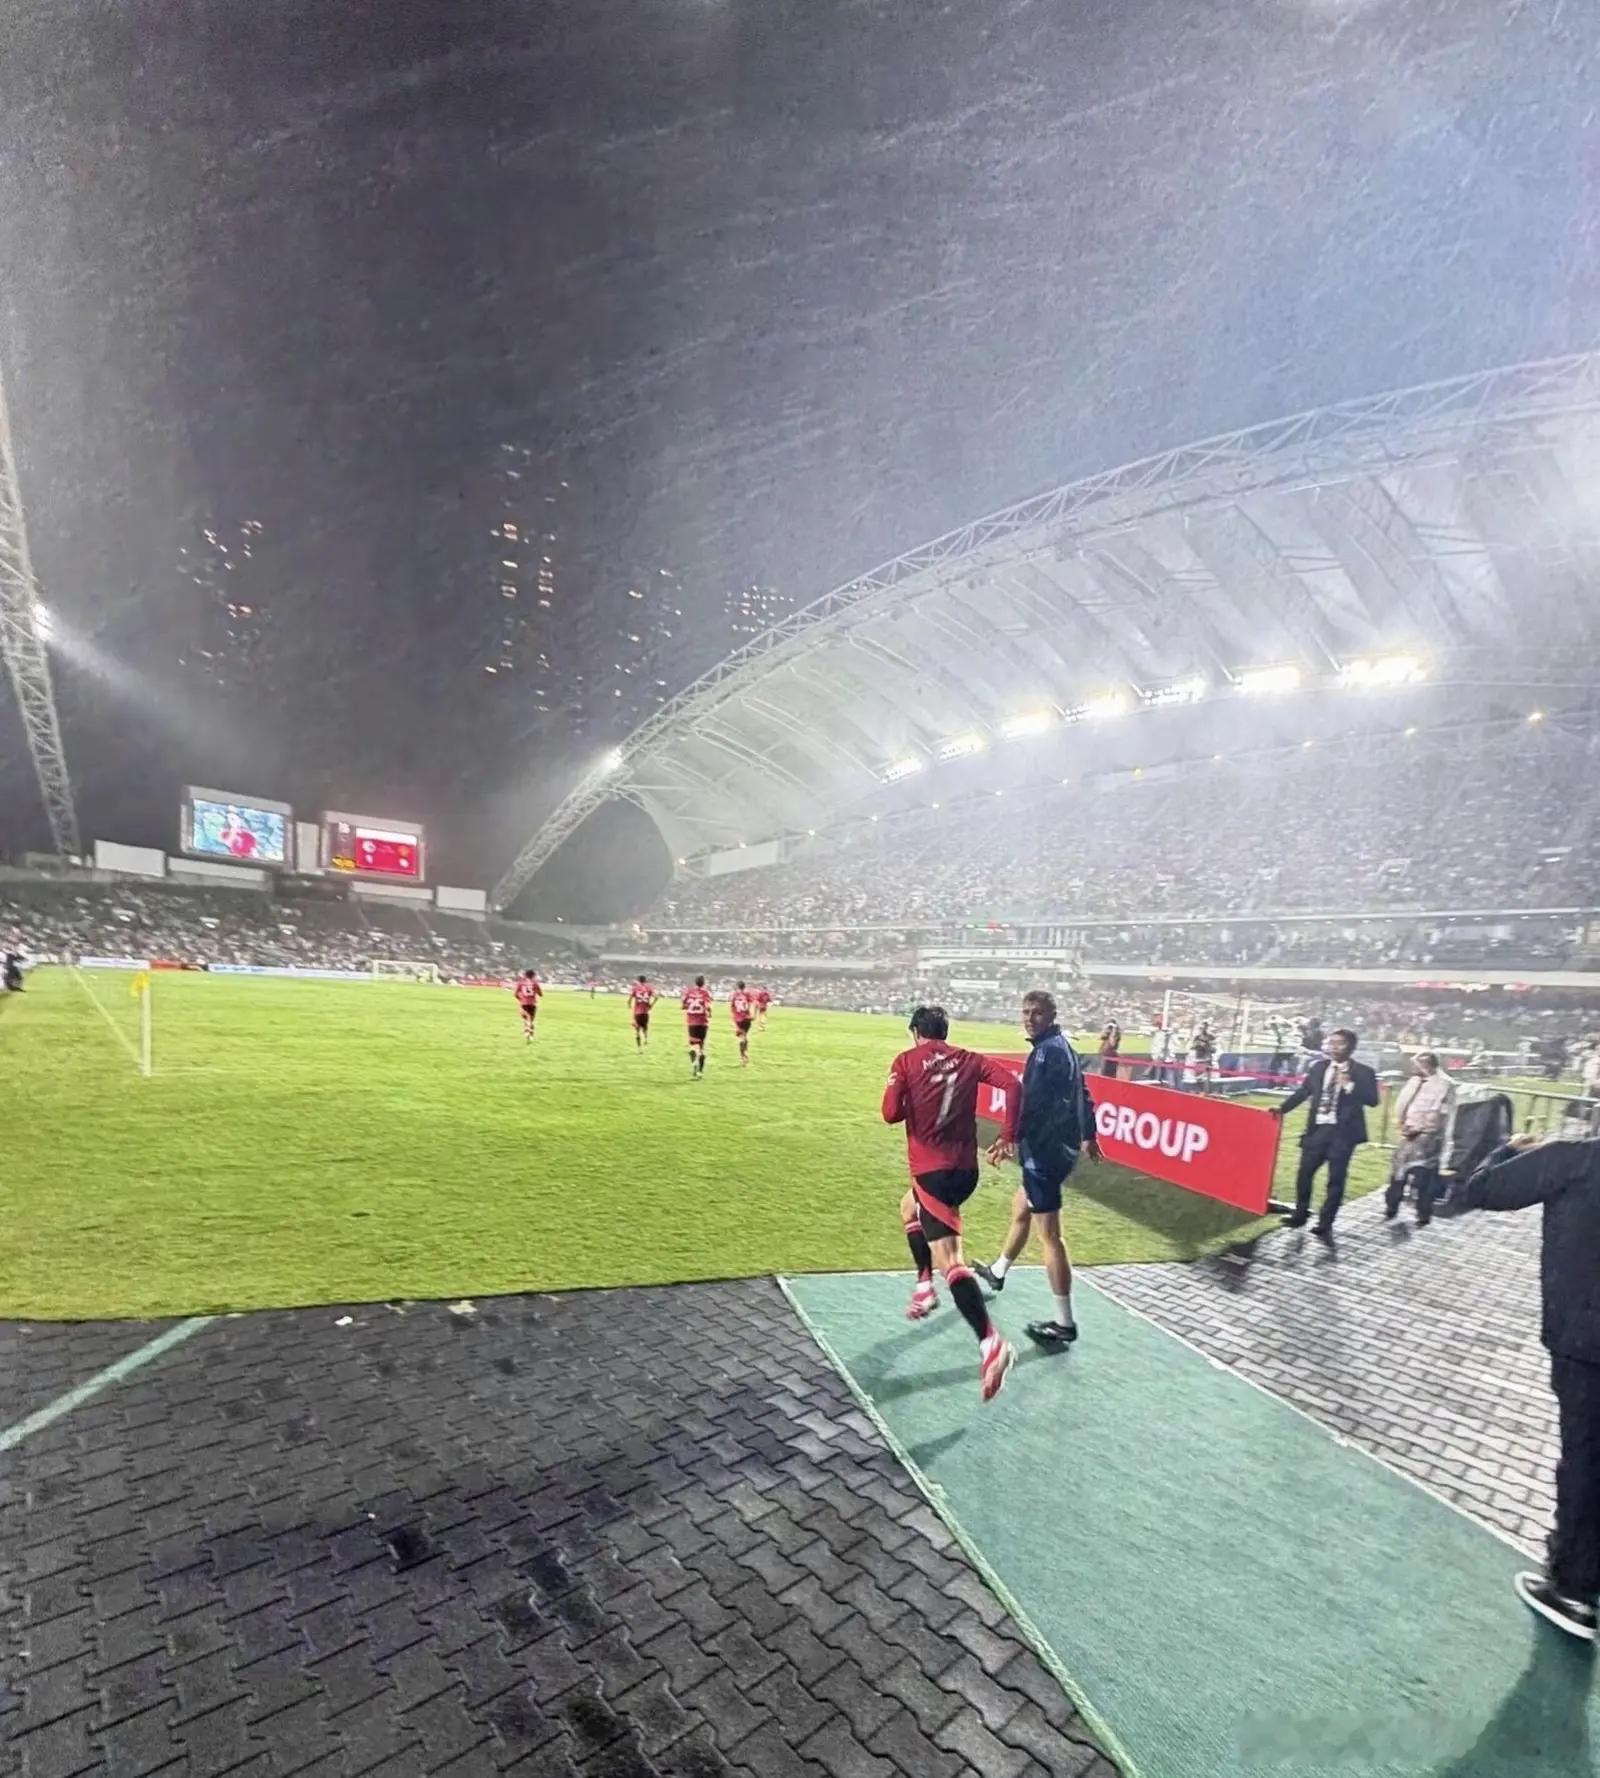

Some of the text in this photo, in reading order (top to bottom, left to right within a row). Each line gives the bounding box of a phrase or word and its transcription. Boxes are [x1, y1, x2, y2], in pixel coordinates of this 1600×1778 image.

[686, 998, 704, 1014] 25
[930, 1071, 959, 1126] 7
[1095, 1101, 1209, 1163] GROUP
